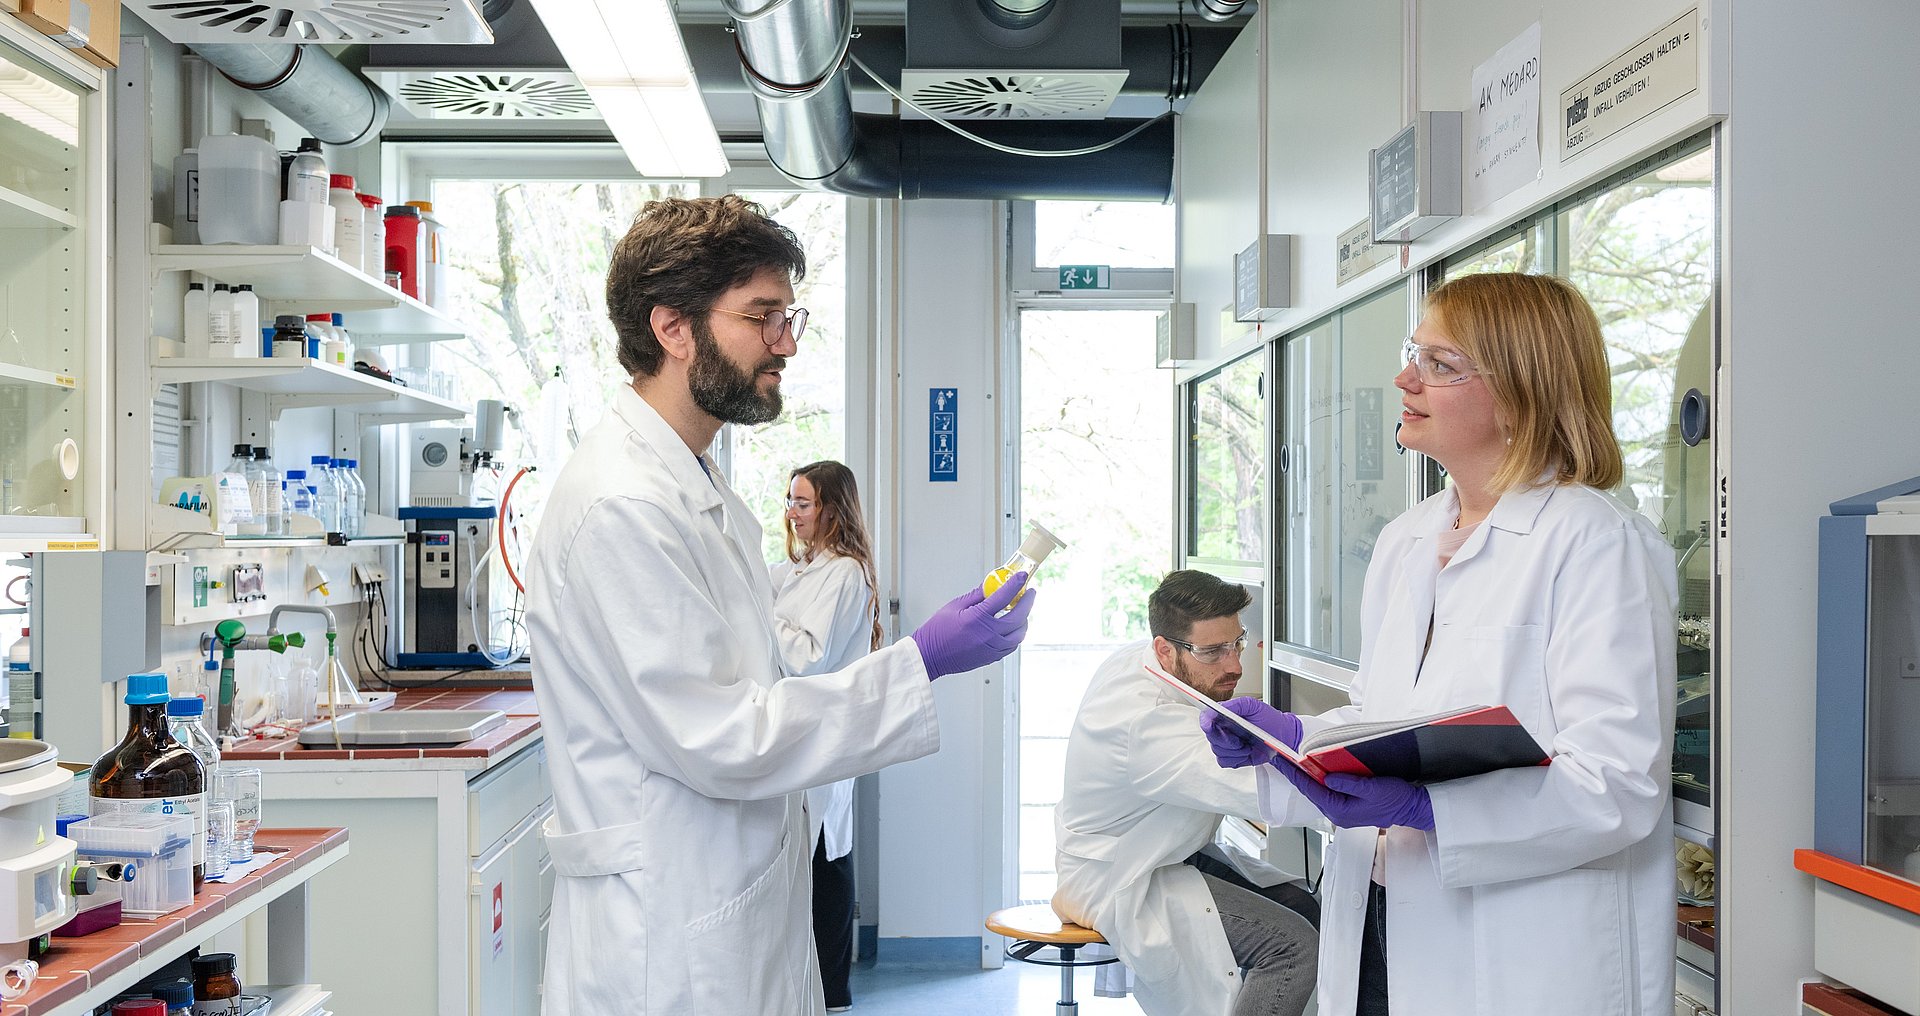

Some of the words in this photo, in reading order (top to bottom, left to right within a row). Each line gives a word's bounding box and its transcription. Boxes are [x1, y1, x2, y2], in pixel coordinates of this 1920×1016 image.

[1479, 79, 1494, 116] AK
[1500, 57, 1538, 102] MEDARD
[1593, 77, 1612, 97] ABZUG
[1613, 50, 1654, 85] GESCHLOSSEN
[1656, 34, 1682, 59] HALTEN
[1593, 99, 1614, 118] UNFALL
[1615, 80, 1646, 105] VERHÜTEN
[1566, 131, 1584, 150] ABZUG
